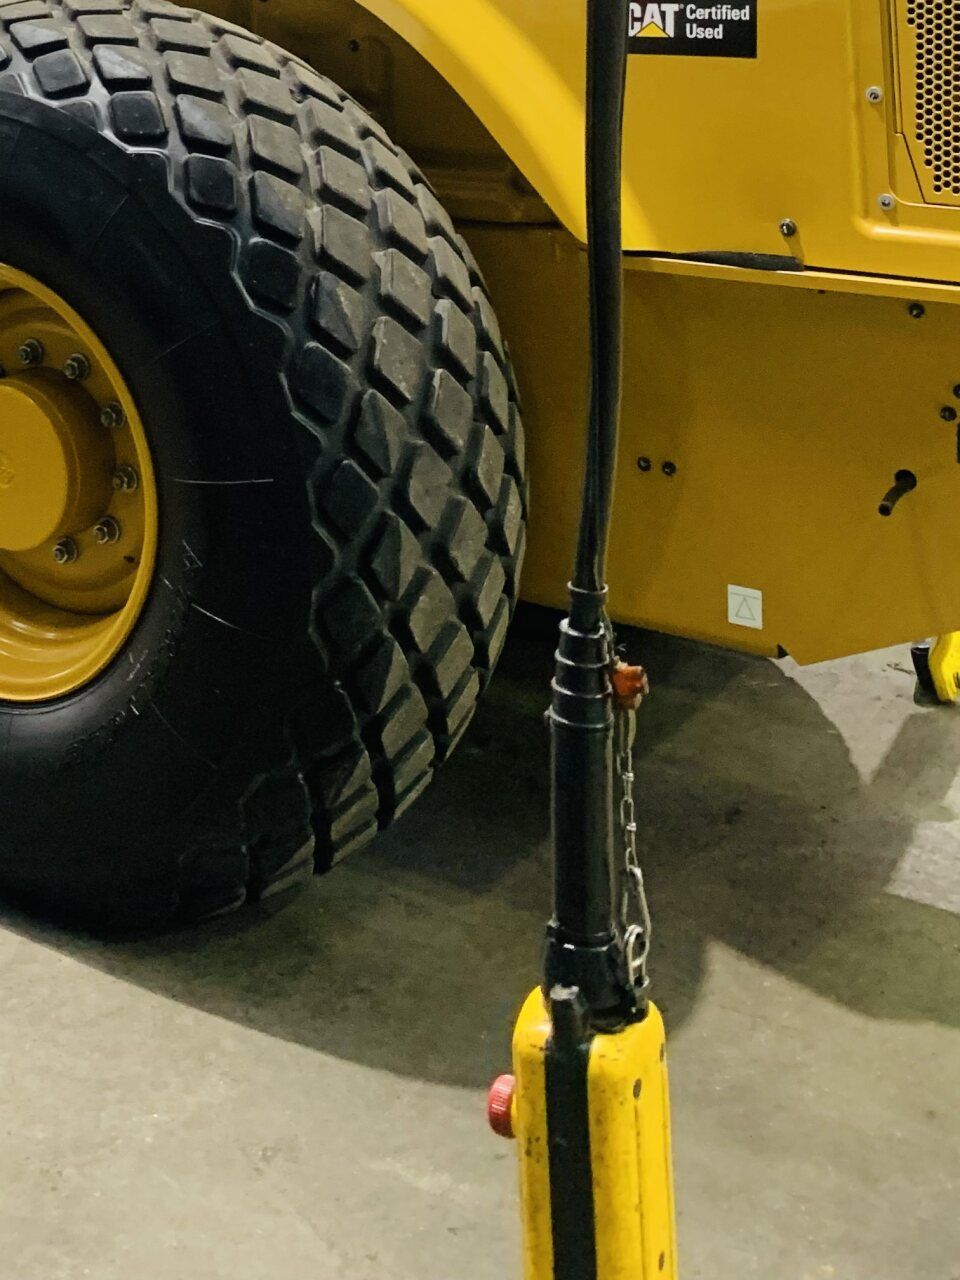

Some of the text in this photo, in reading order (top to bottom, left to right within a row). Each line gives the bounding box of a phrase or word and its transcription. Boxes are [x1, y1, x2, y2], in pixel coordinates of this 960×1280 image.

[628, 2, 679, 38] CAT
[686, 4, 750, 21] Certified
[686, 24, 723, 39] Used
